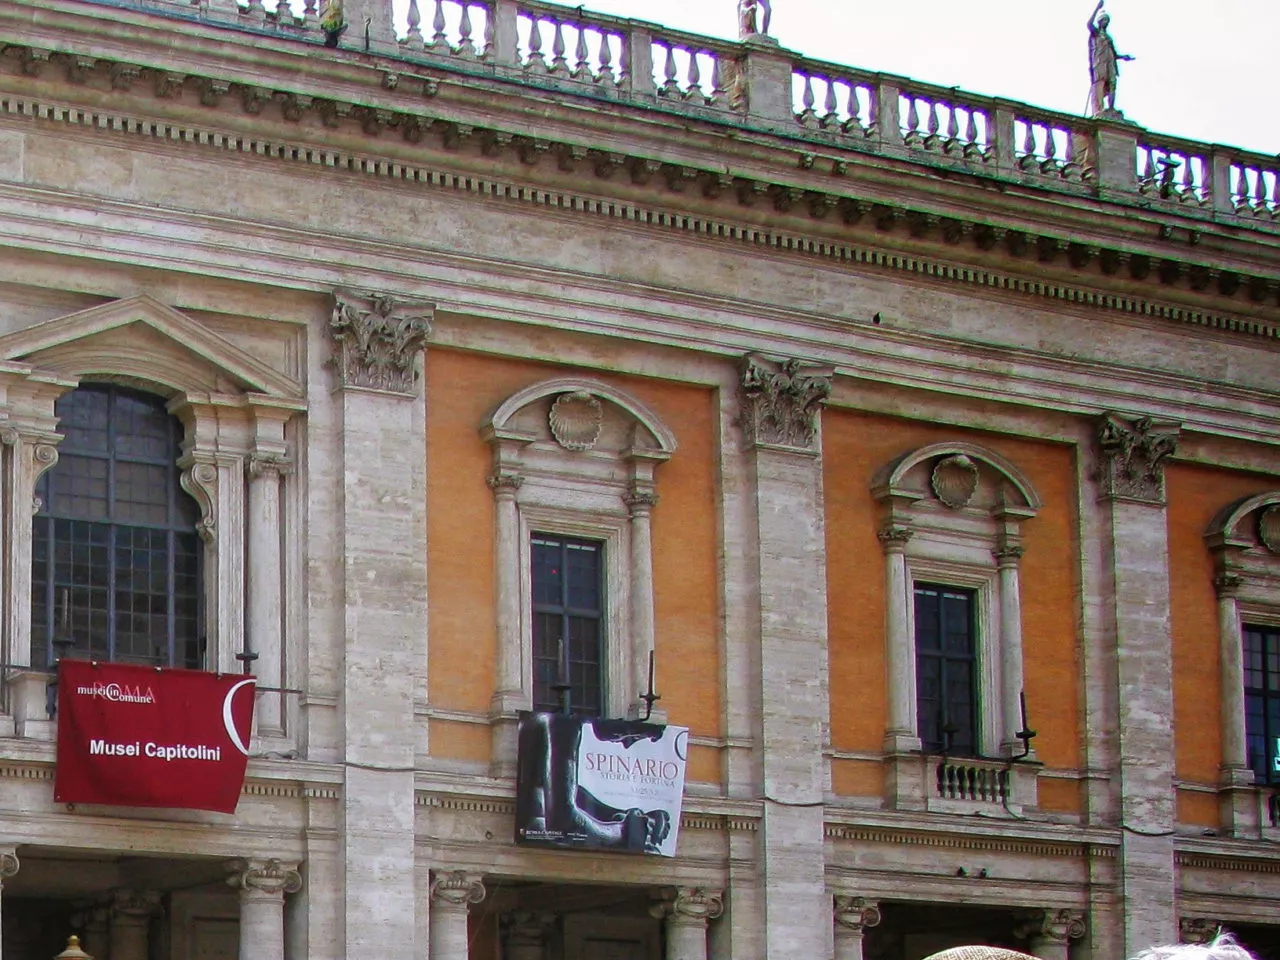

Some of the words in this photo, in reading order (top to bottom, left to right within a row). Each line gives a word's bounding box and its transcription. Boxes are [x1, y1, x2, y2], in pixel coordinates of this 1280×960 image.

[90, 739, 140, 756] Musei
[144, 742, 221, 761] Capitolini
[585, 752, 678, 780] SPINARIO
